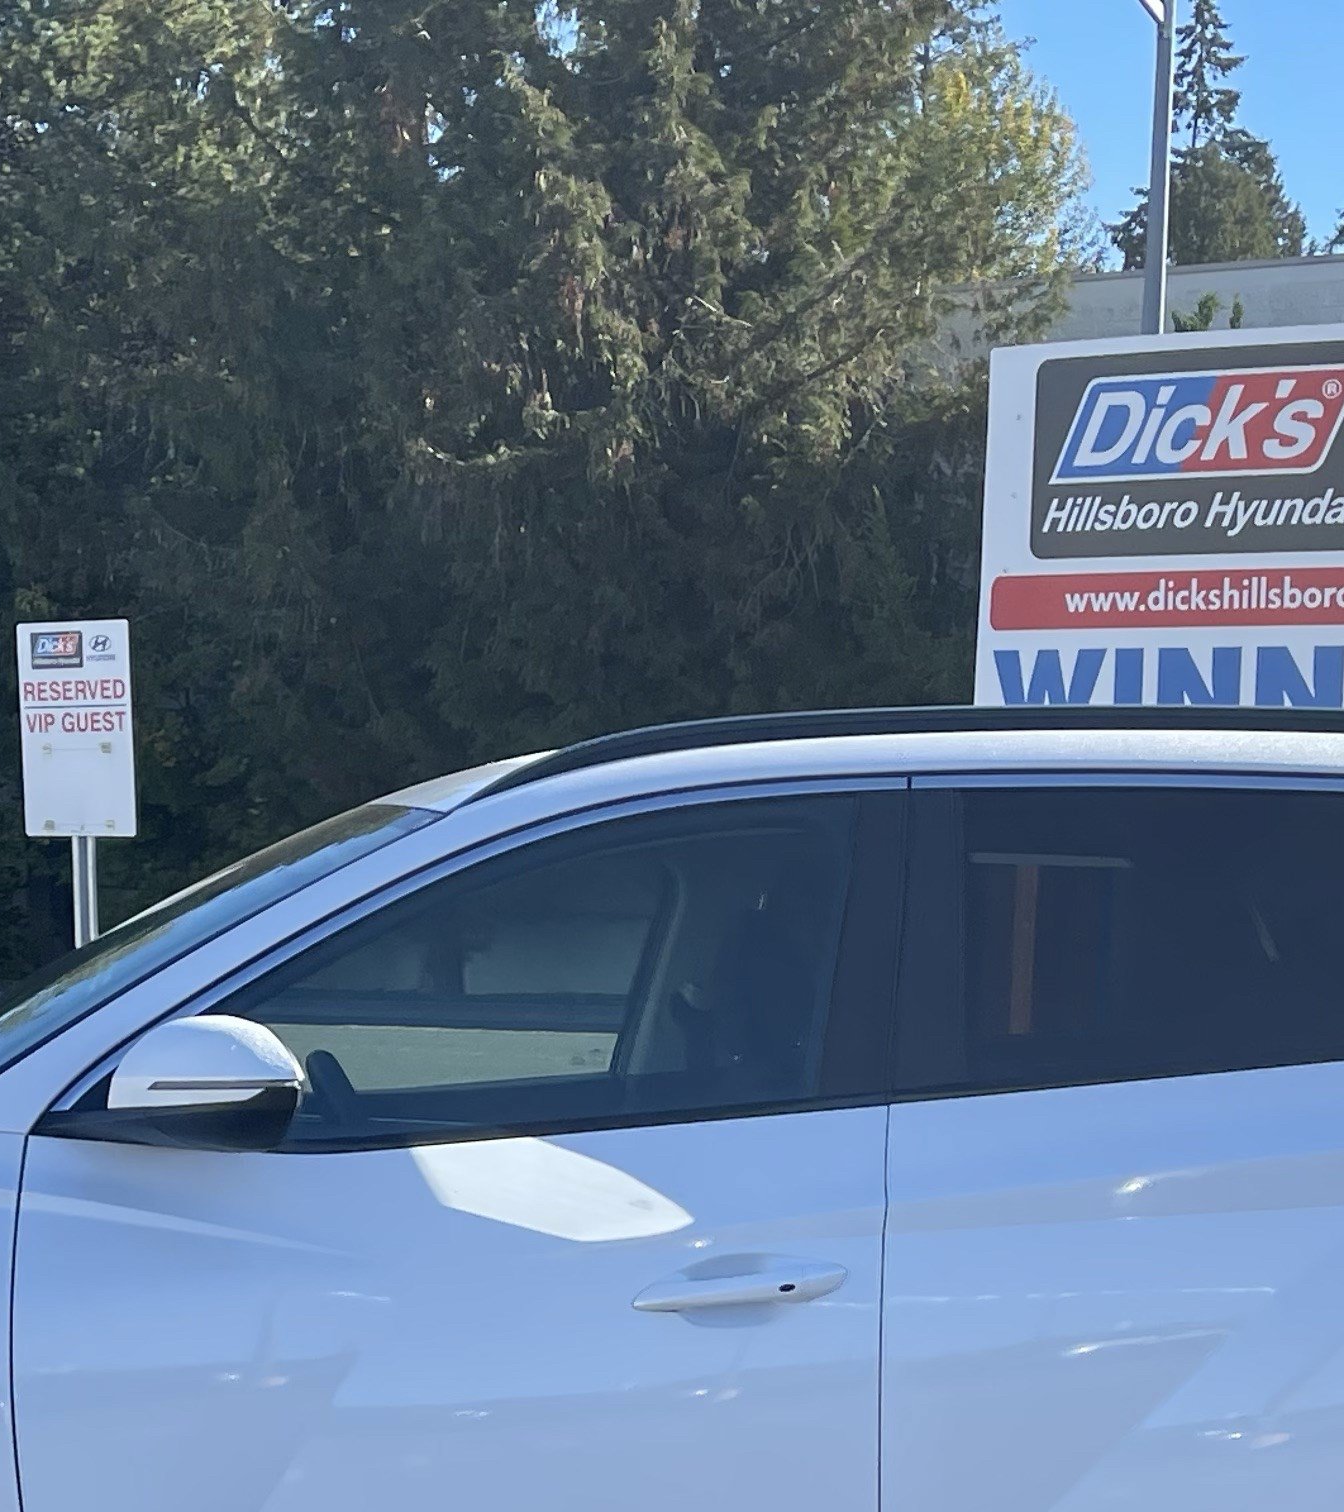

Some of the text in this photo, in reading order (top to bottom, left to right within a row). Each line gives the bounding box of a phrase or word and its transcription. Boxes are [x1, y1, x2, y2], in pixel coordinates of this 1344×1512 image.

[1041, 495, 1199, 534] Hillsboro
[23, 679, 125, 701] RESERVED
[26, 711, 126, 733] VIP GUEST
